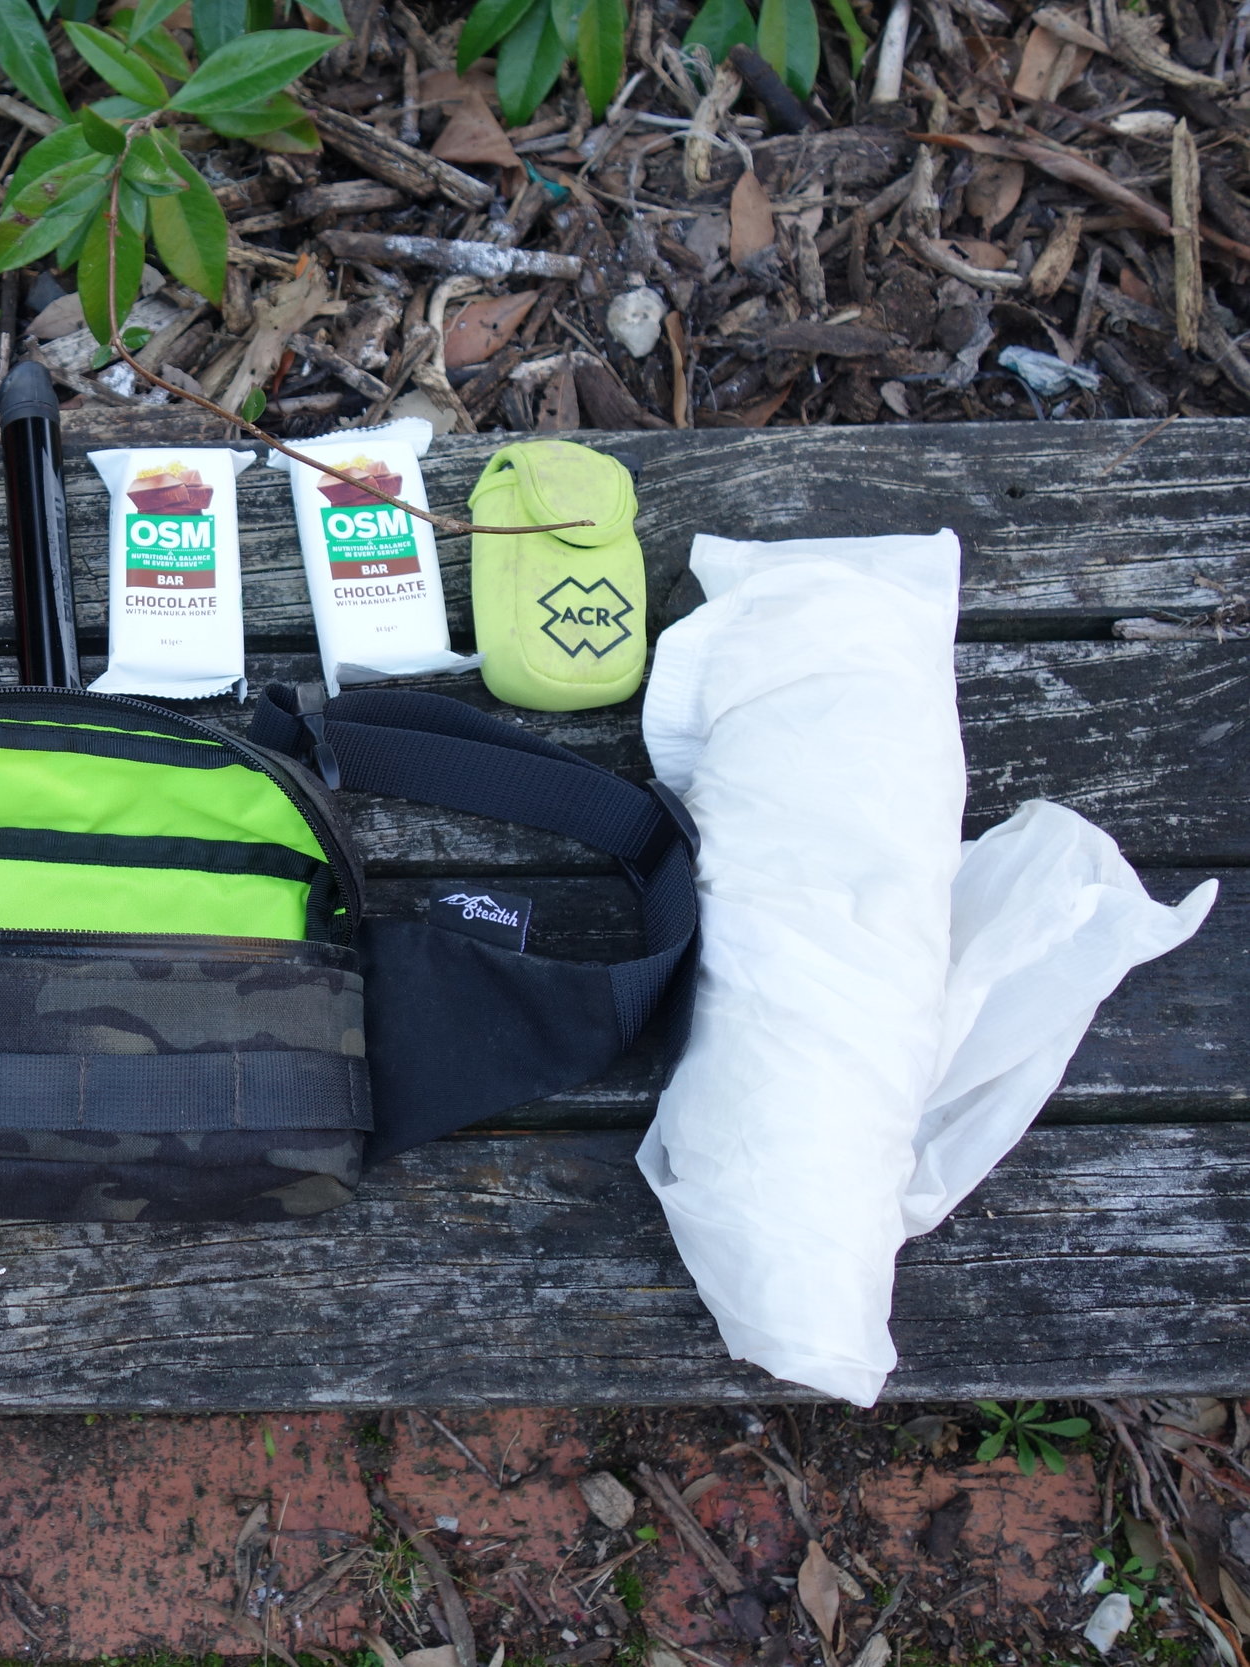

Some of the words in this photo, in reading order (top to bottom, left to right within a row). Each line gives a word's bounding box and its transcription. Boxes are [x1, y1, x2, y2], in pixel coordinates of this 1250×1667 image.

[327, 508, 409, 539] OSM
[130, 520, 211, 549] OSM
[332, 543, 378, 552] NUTRITIONAL
[379, 541, 411, 550] BALANCE
[131, 553, 178, 561] NUTRITIONAL
[361, 563, 389, 576] BAR
[157, 575, 184, 586] BAR
[334, 580, 426, 599] CHOCOLATE
[125, 595, 217, 608] CHOCOLATE
[336, 599, 358, 607] WITH
[360, 597, 397, 606] MANUKA
[399, 592, 427, 601] HONEY
[560, 606, 611, 627] ACR
[462, 902, 519, 927] Stealth
